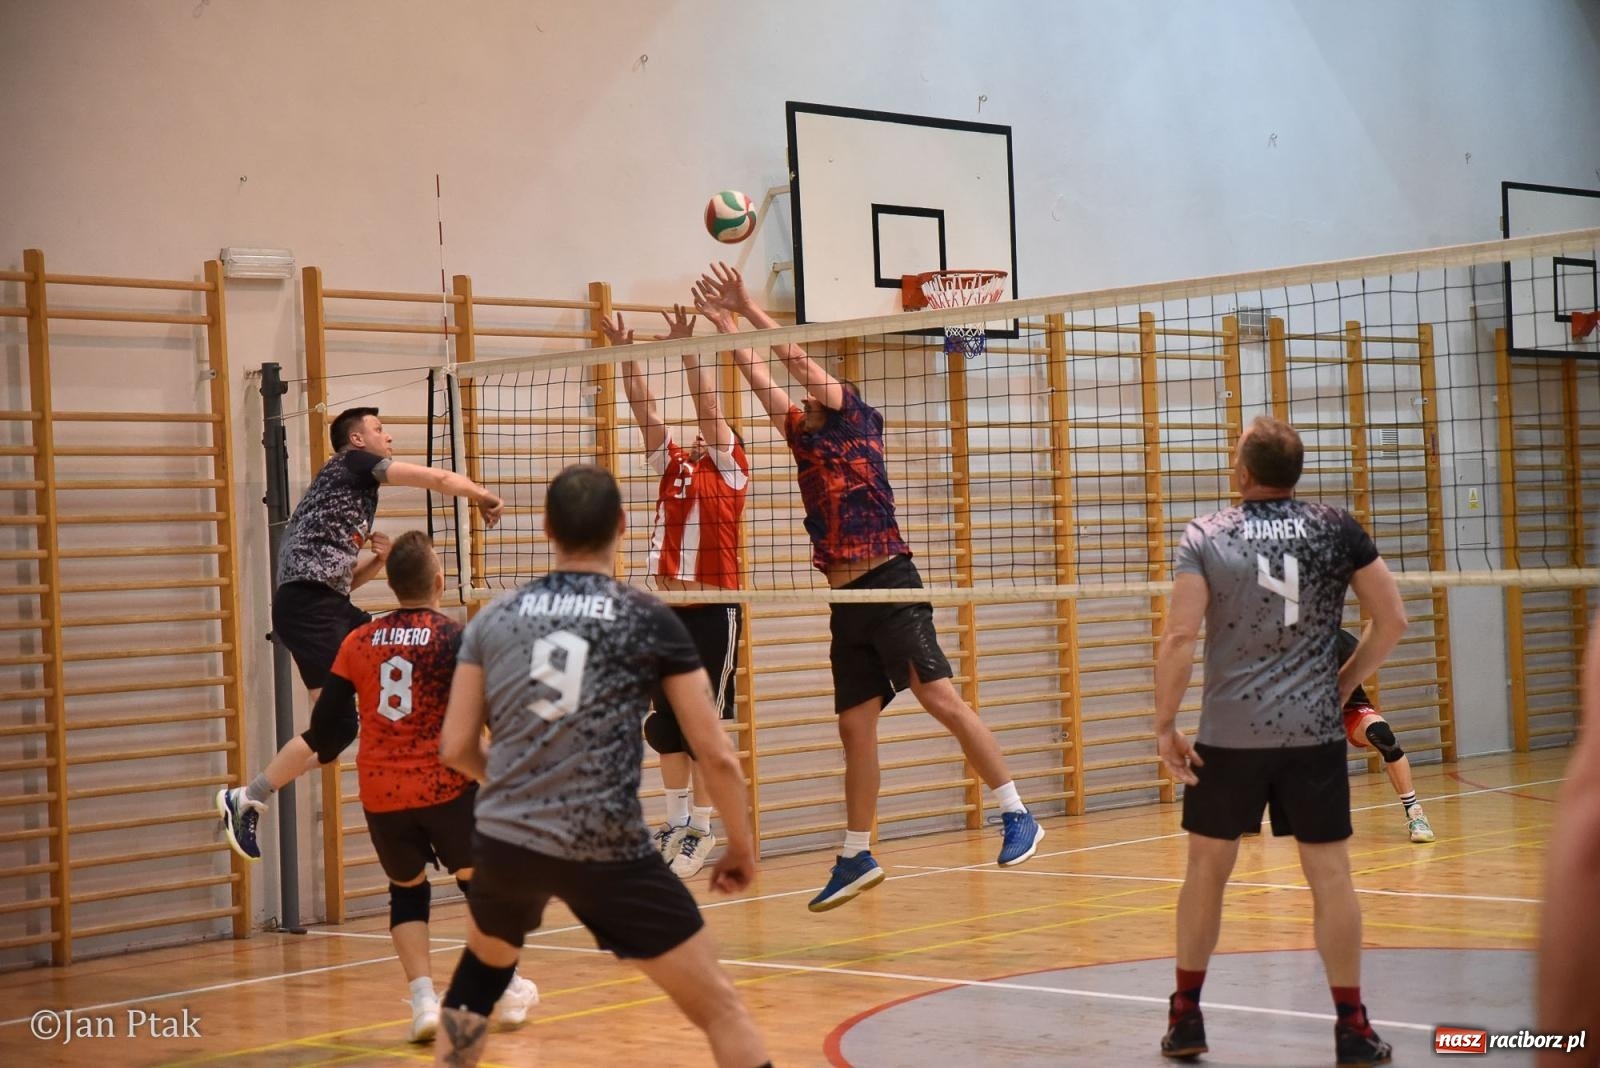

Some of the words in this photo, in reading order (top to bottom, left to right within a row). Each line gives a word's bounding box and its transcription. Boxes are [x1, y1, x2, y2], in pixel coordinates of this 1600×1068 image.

[1244, 518, 1307, 540] #JAREK
[1257, 553, 1300, 628] 4
[377, 655, 413, 722] 8
[527, 630, 590, 721] 9
